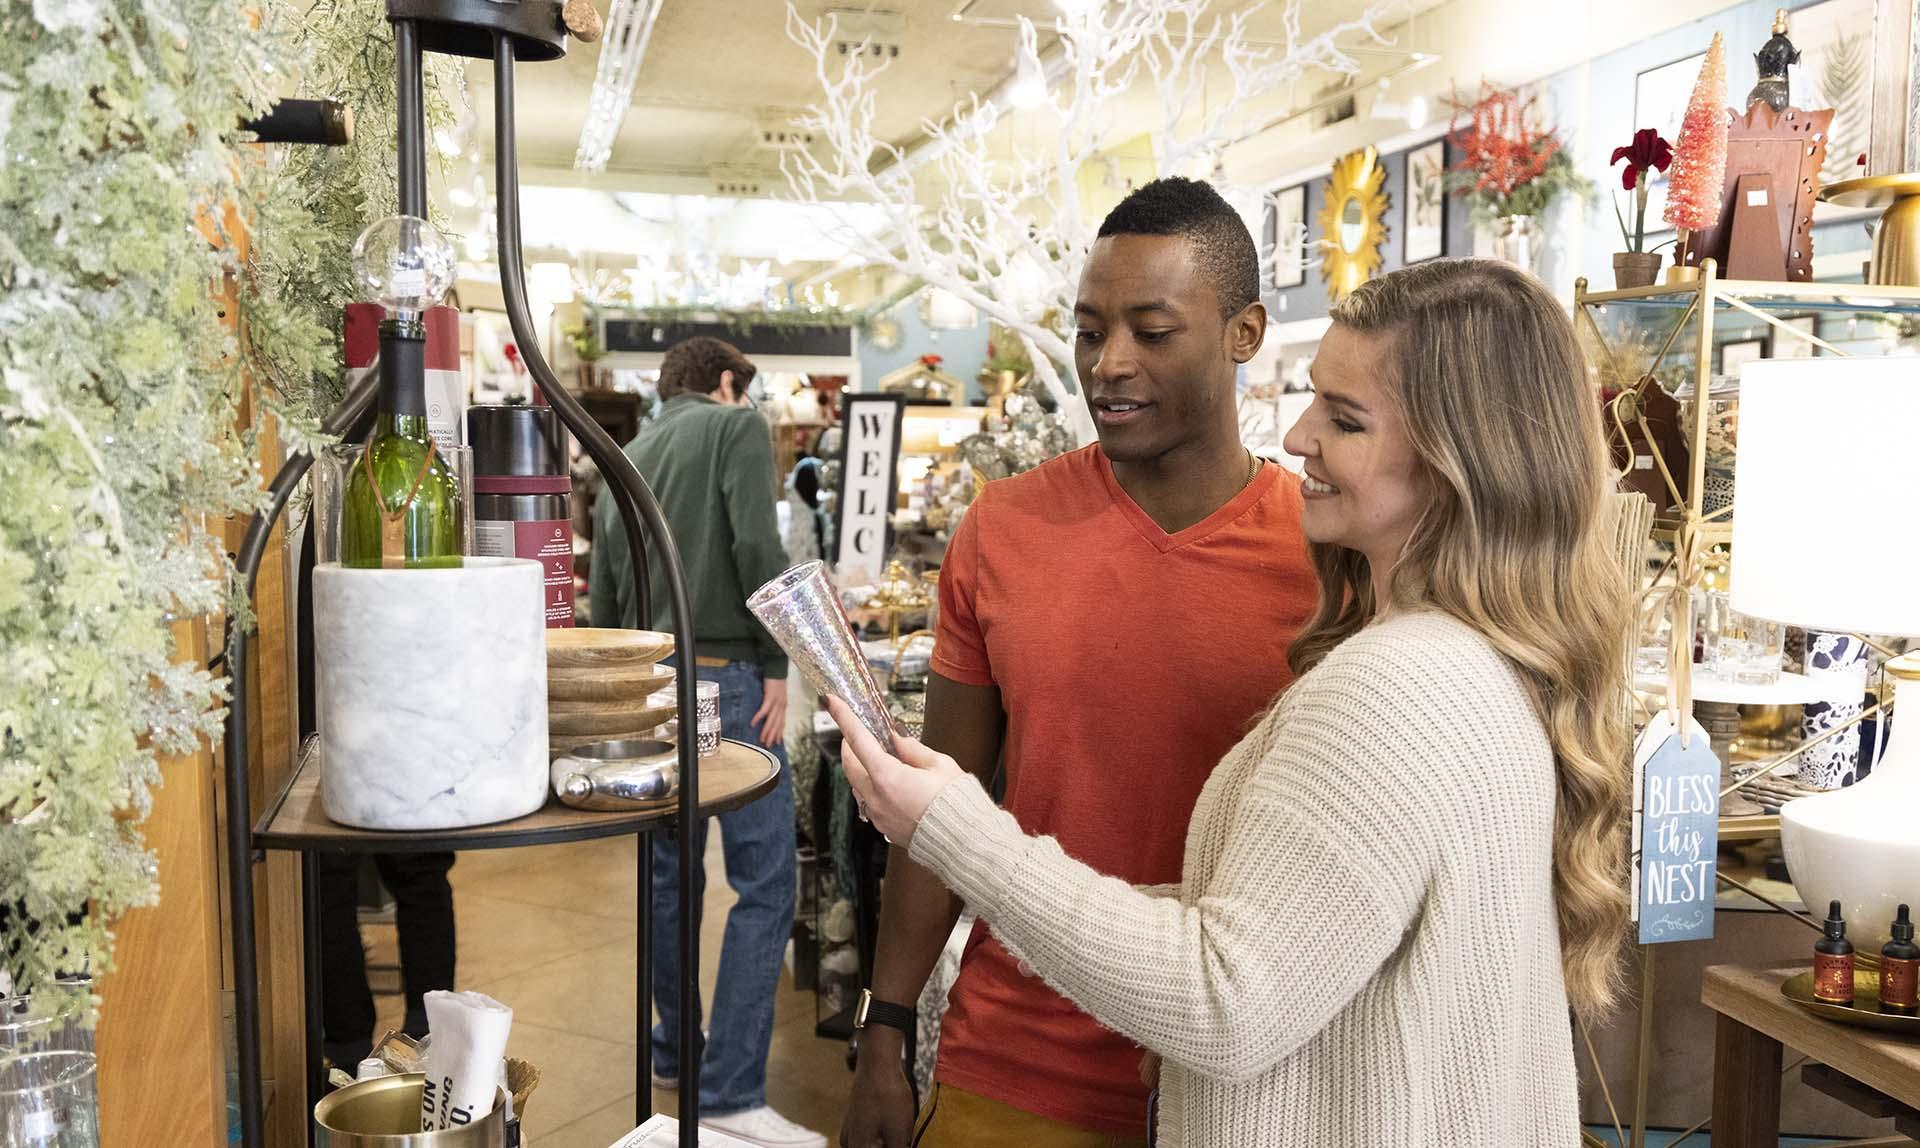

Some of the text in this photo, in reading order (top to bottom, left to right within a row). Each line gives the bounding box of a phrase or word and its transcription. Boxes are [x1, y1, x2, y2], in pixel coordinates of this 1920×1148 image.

[1649, 774, 1716, 818] BLESS
[1654, 817, 1704, 862] this
[1647, 860, 1713, 905] NEST
